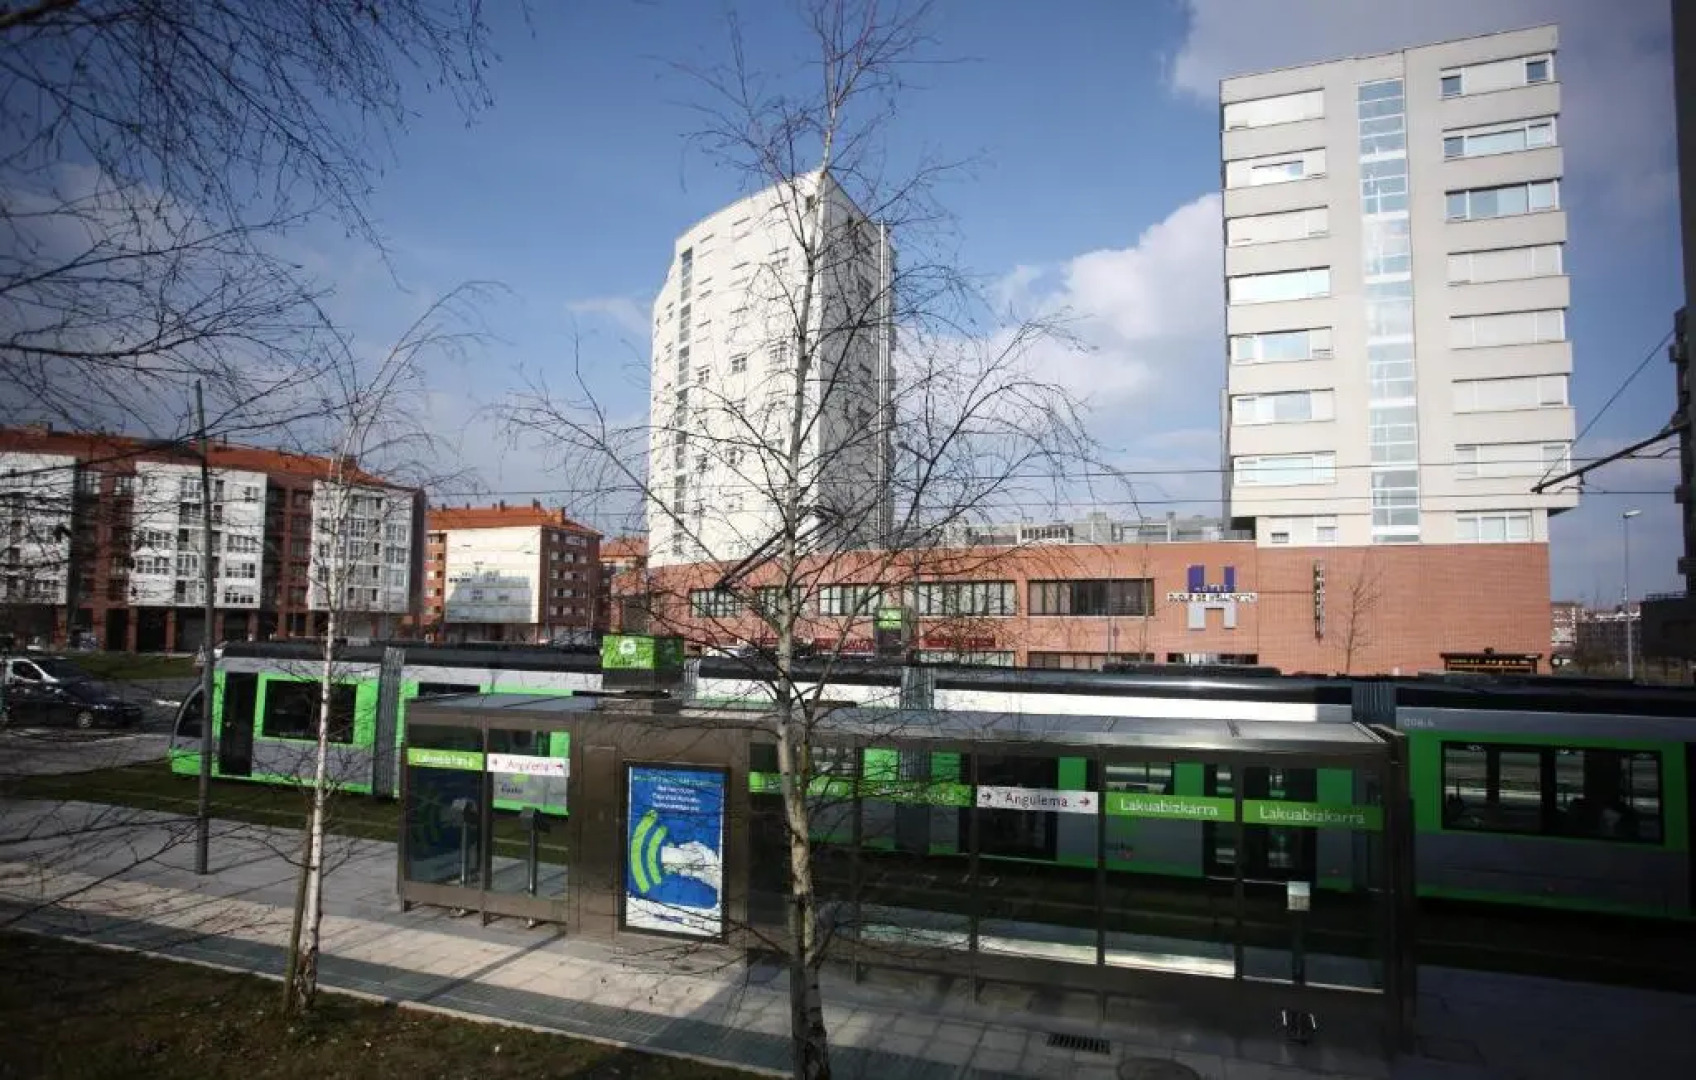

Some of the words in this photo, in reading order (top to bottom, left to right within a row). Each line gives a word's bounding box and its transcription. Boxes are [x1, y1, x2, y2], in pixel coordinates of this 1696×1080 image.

[1004, 792, 1069, 808] Angulema
[1120, 798, 1219, 816] Lakuabizkarra
[1259, 804, 1366, 824] Lakuabizkarra
